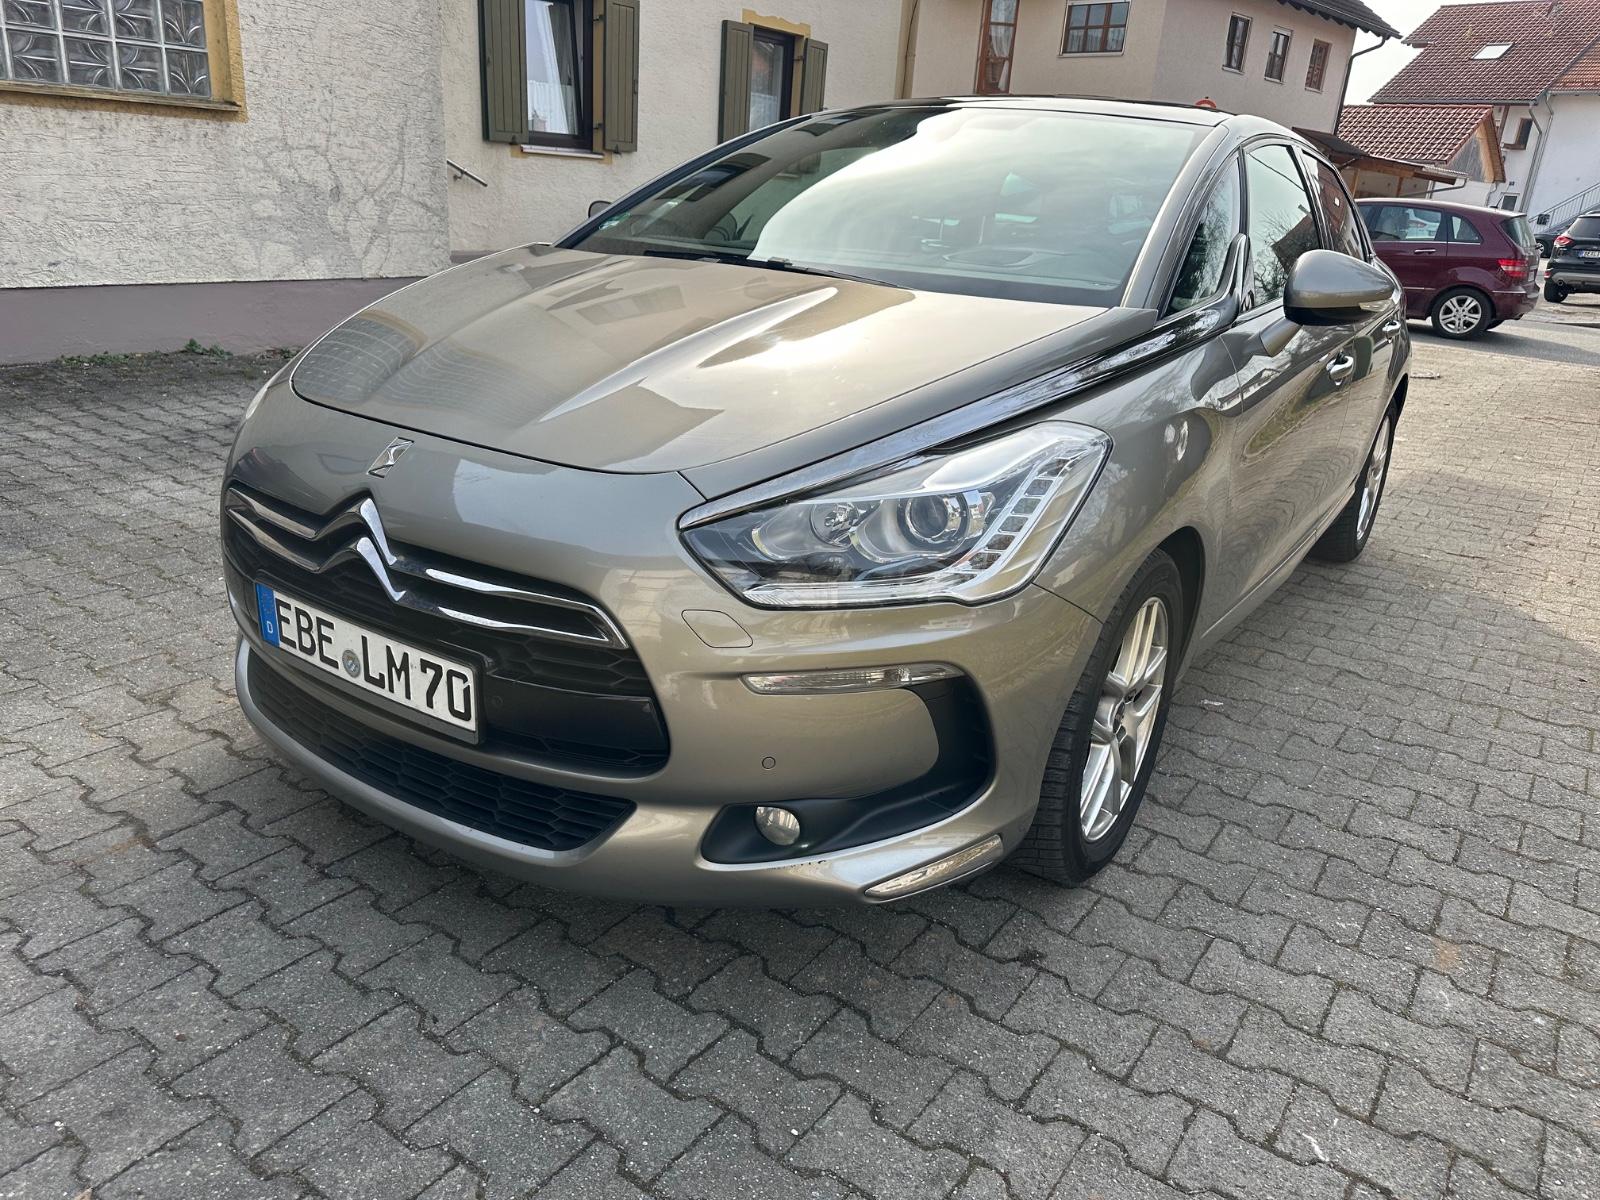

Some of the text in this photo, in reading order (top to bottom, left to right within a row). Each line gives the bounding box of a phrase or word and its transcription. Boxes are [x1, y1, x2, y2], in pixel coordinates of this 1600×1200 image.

[266, 620, 273, 634] D
[275, 598, 471, 722] EBE LM 70
